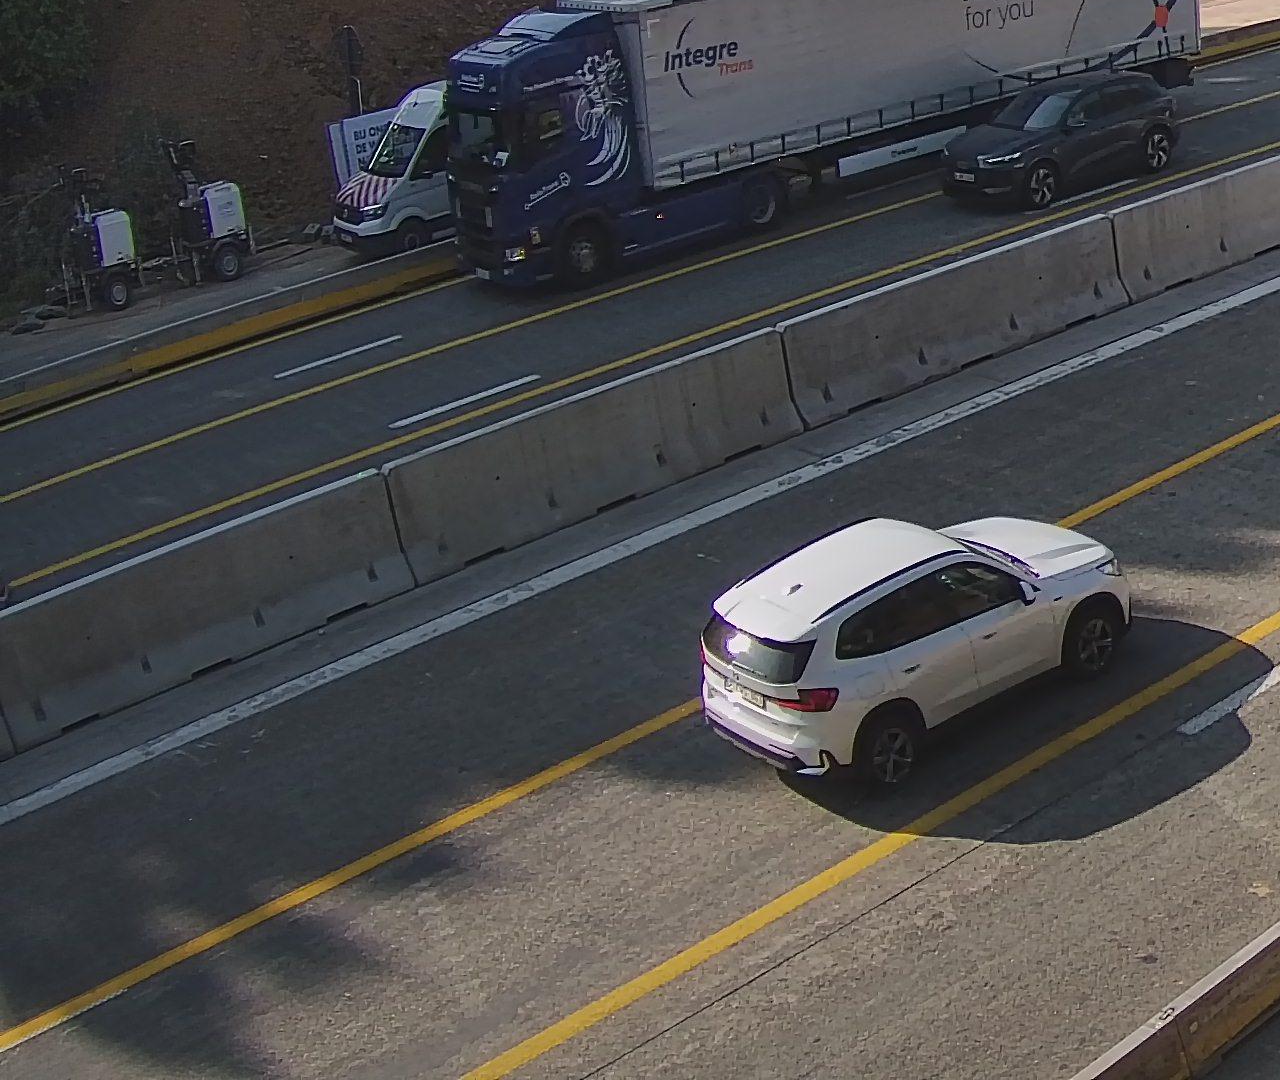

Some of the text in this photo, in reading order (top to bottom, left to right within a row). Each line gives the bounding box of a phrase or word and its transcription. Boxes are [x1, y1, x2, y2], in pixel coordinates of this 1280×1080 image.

[965, 0, 1034, 31] for you
[663, 40, 738, 73] Integre
[717, 59, 754, 77] Trans
